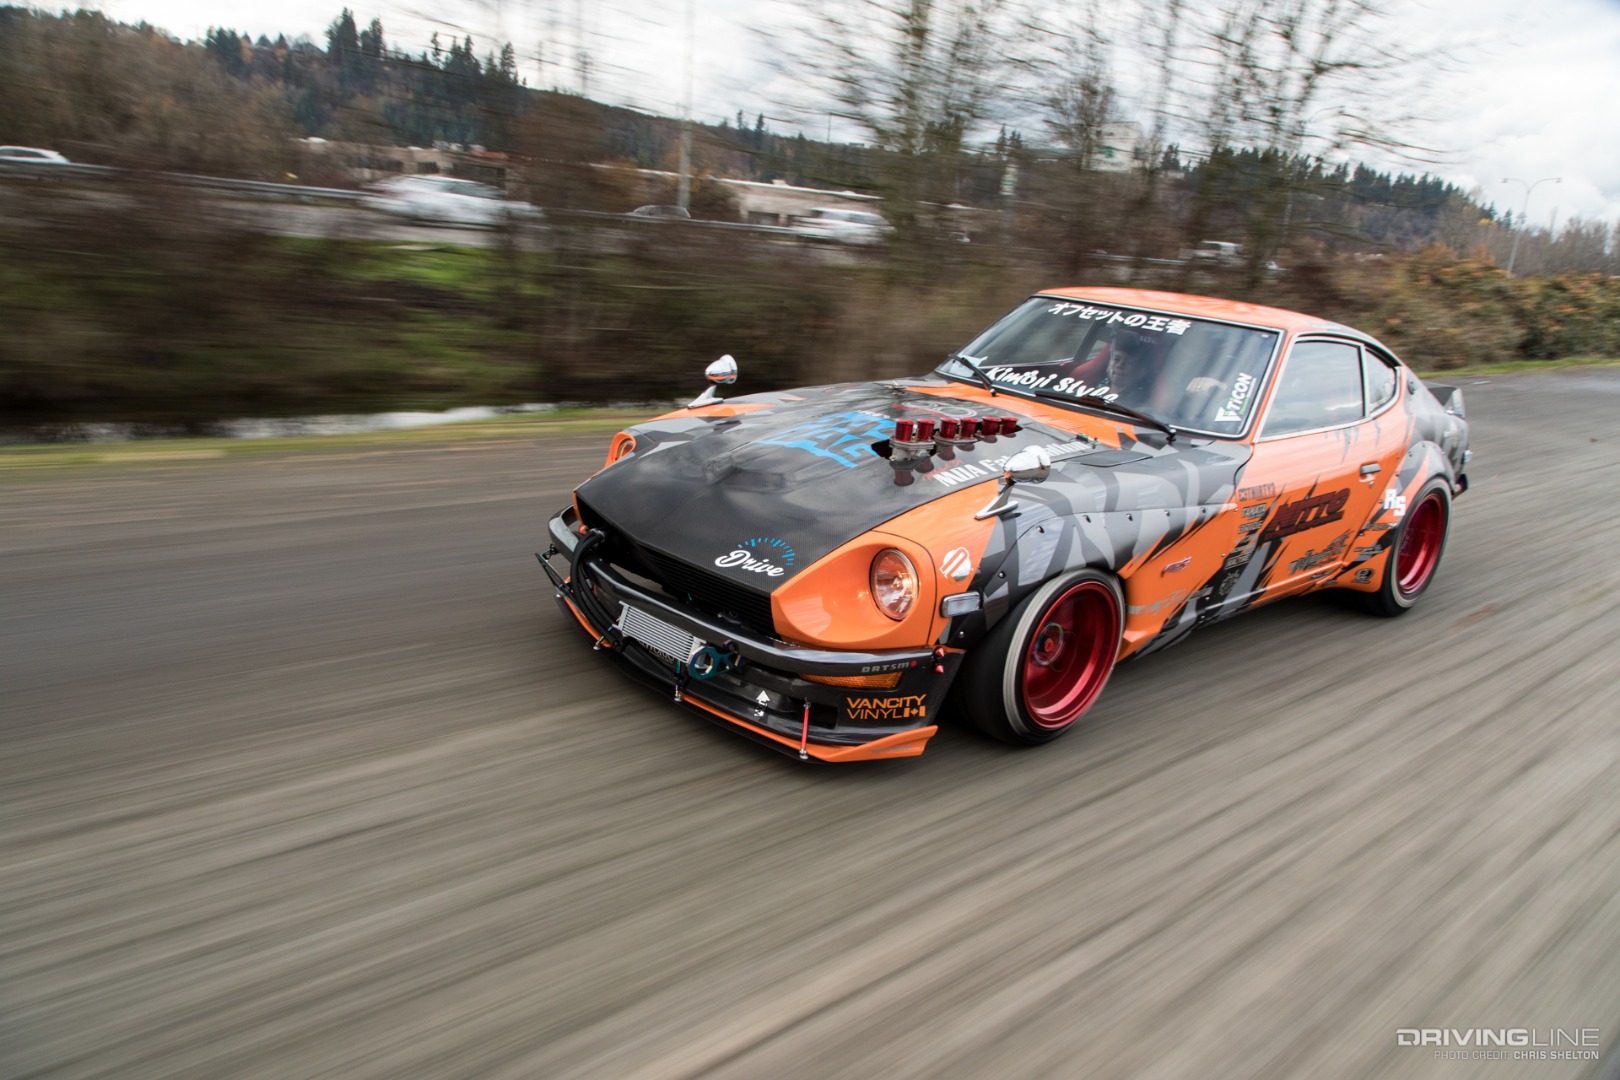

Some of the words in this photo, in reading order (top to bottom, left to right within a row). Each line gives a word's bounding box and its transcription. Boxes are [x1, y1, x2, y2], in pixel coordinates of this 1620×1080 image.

[1048, 302, 1191, 335] オフセットの王者
[1264, 488, 1351, 533] NITTO
[714, 549, 784, 576] Drive
[846, 693, 927, 709] VANCITY
[846, 707, 903, 720] VINYL
